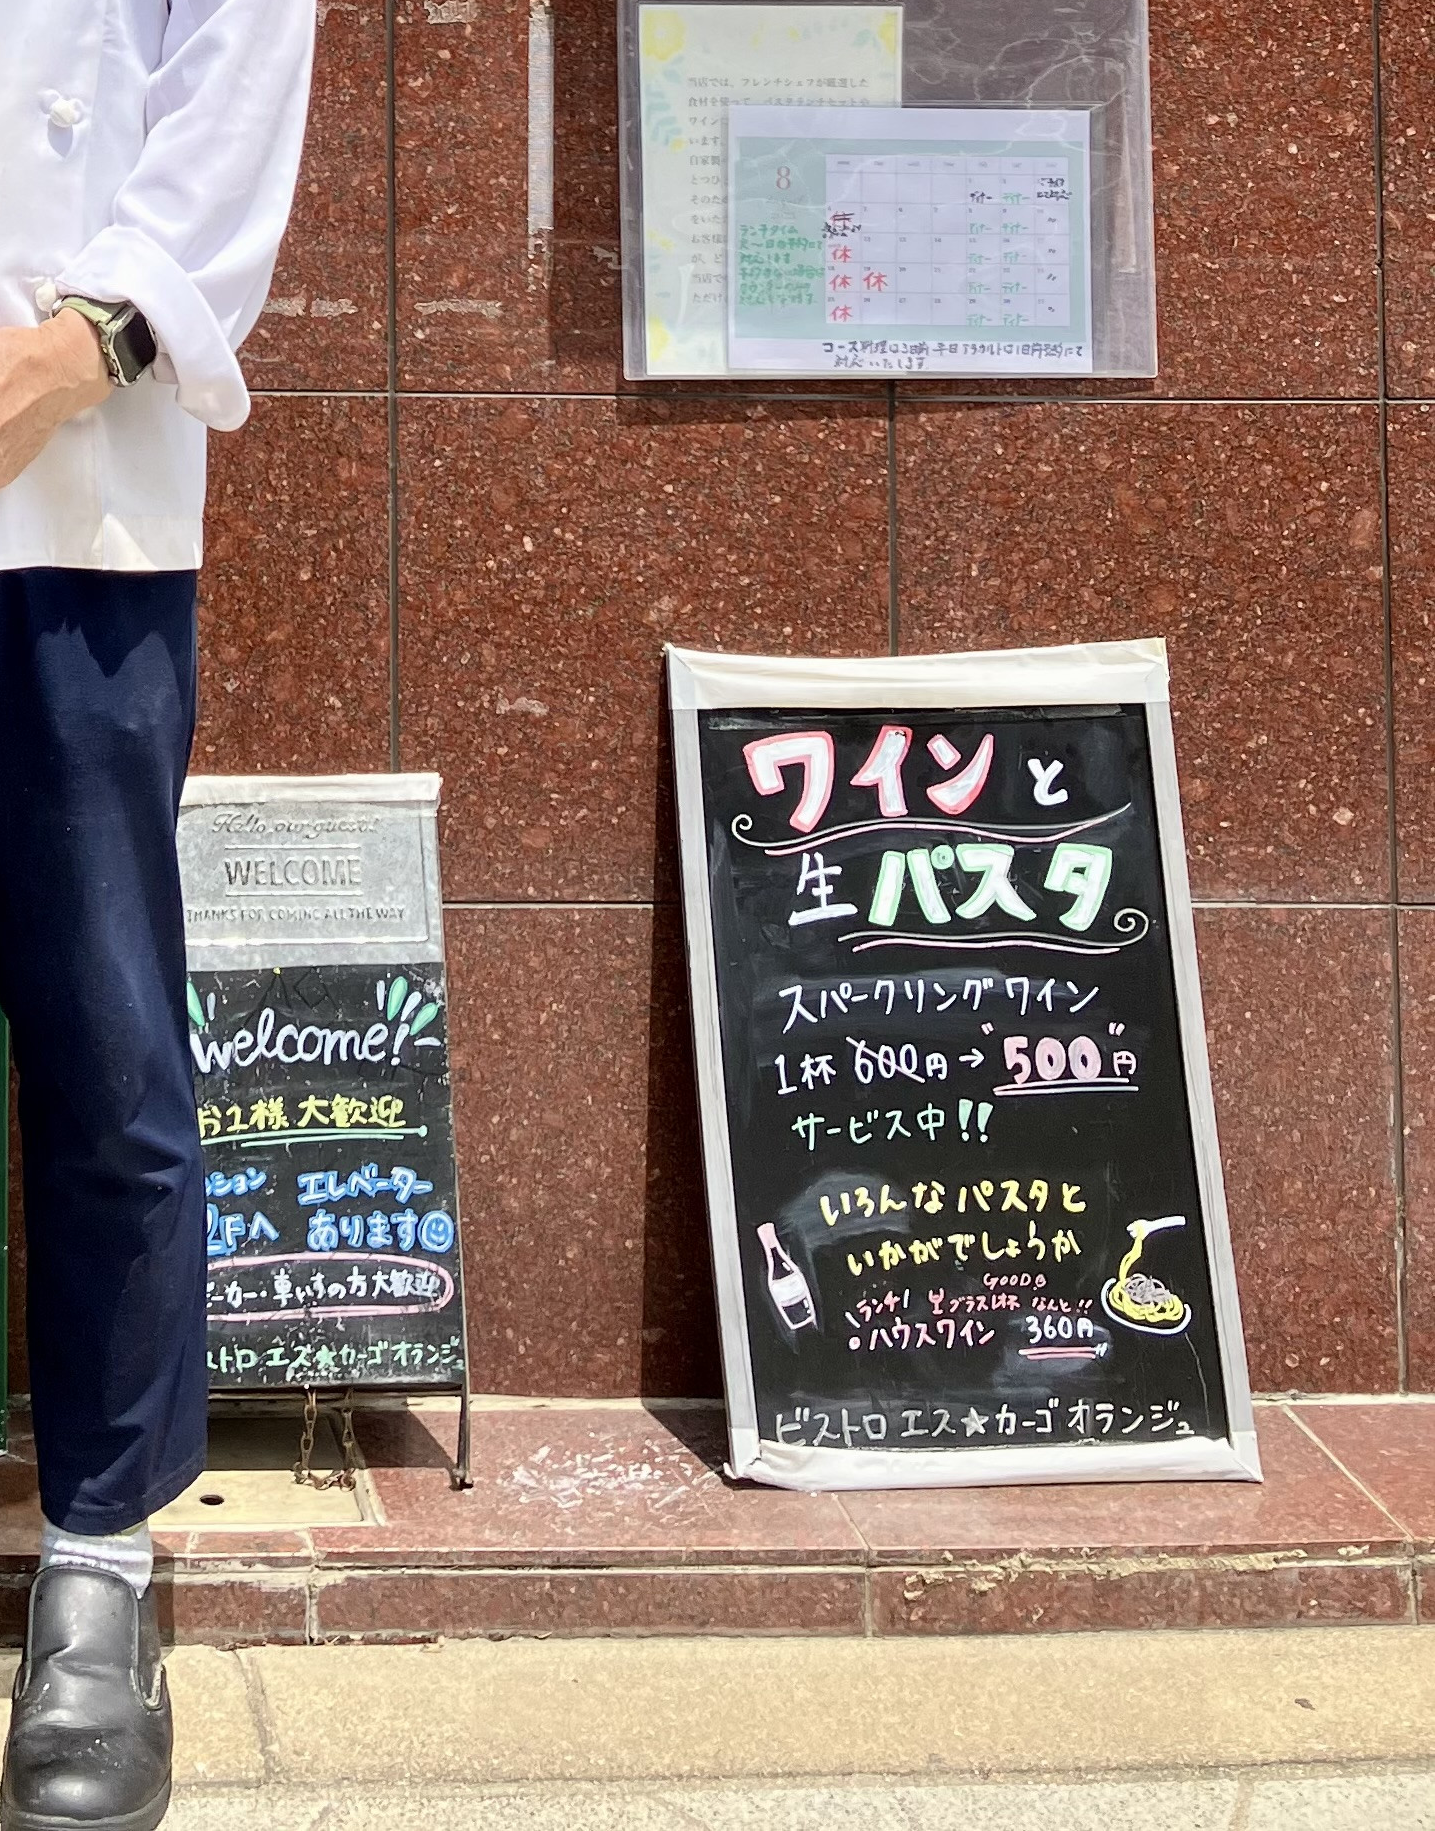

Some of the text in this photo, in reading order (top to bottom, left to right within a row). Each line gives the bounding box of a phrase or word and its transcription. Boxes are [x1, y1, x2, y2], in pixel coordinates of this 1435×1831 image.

[776, 165, 791, 190] 8
[831, 245, 852, 263] 休
[829, 273, 853, 291] 休
[862, 271, 888, 292] 休
[830, 304, 853, 323] 休
[223, 857, 363, 887] WELCOME
[788, 842, 1114, 932] 生パスタ
[186, 907, 237, 923] THANKS
[240, 908, 264, 922] FOR
[268, 906, 321, 921] COMING
[346, 906, 374, 920] THE
[375, 906, 406, 920] WAY
[778, 976, 1100, 1034] スパークリングワイン
[297, 1092, 407, 1129] 大歓迎
[297, 1162, 434, 1206] エレベーター
[307, 1208, 419, 1252] あります
[847, 1220, 1082, 1277] いかがでしょうか
[856, 1290, 901, 1323] ランチ
[869, 1315, 1095, 1352] ハウスワイン 360円
[776, 1406, 888, 1447] ビストロ
[1067, 1398, 1196, 1436] オランジュ
